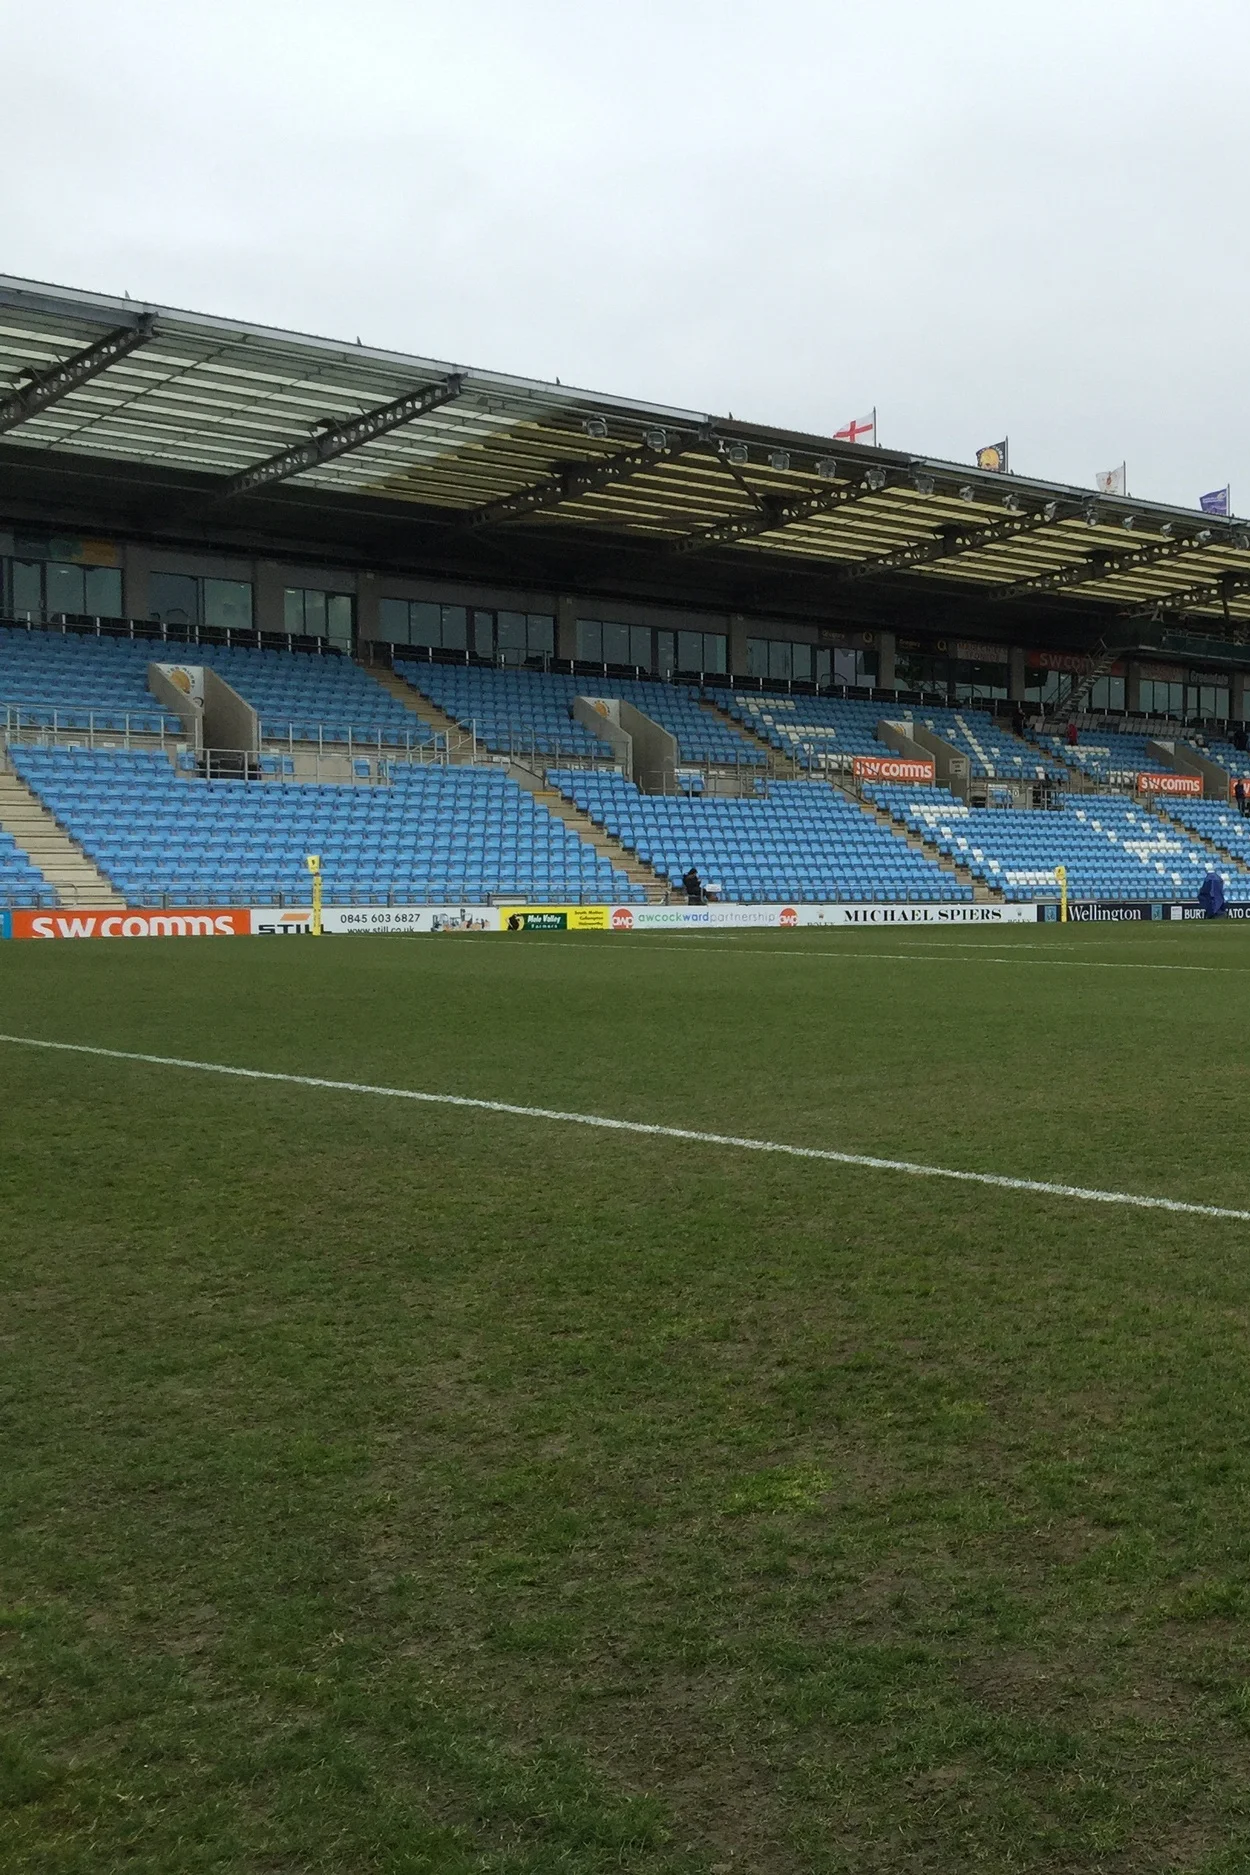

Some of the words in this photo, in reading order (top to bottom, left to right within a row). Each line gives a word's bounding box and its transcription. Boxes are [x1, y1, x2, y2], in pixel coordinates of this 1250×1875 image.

[340, 914, 368, 923] 0845
[371, 914, 391, 923] 603
[394, 913, 421, 922] 6827
[844, 909, 934, 922] MICHAEL
[938, 908, 1002, 921] SPIERS
[1068, 904, 1142, 921] Wellington
[1184, 908, 1206, 919] BURT
[1226, 908, 1244, 919] ATO
[258, 924, 332, 935] STILL
